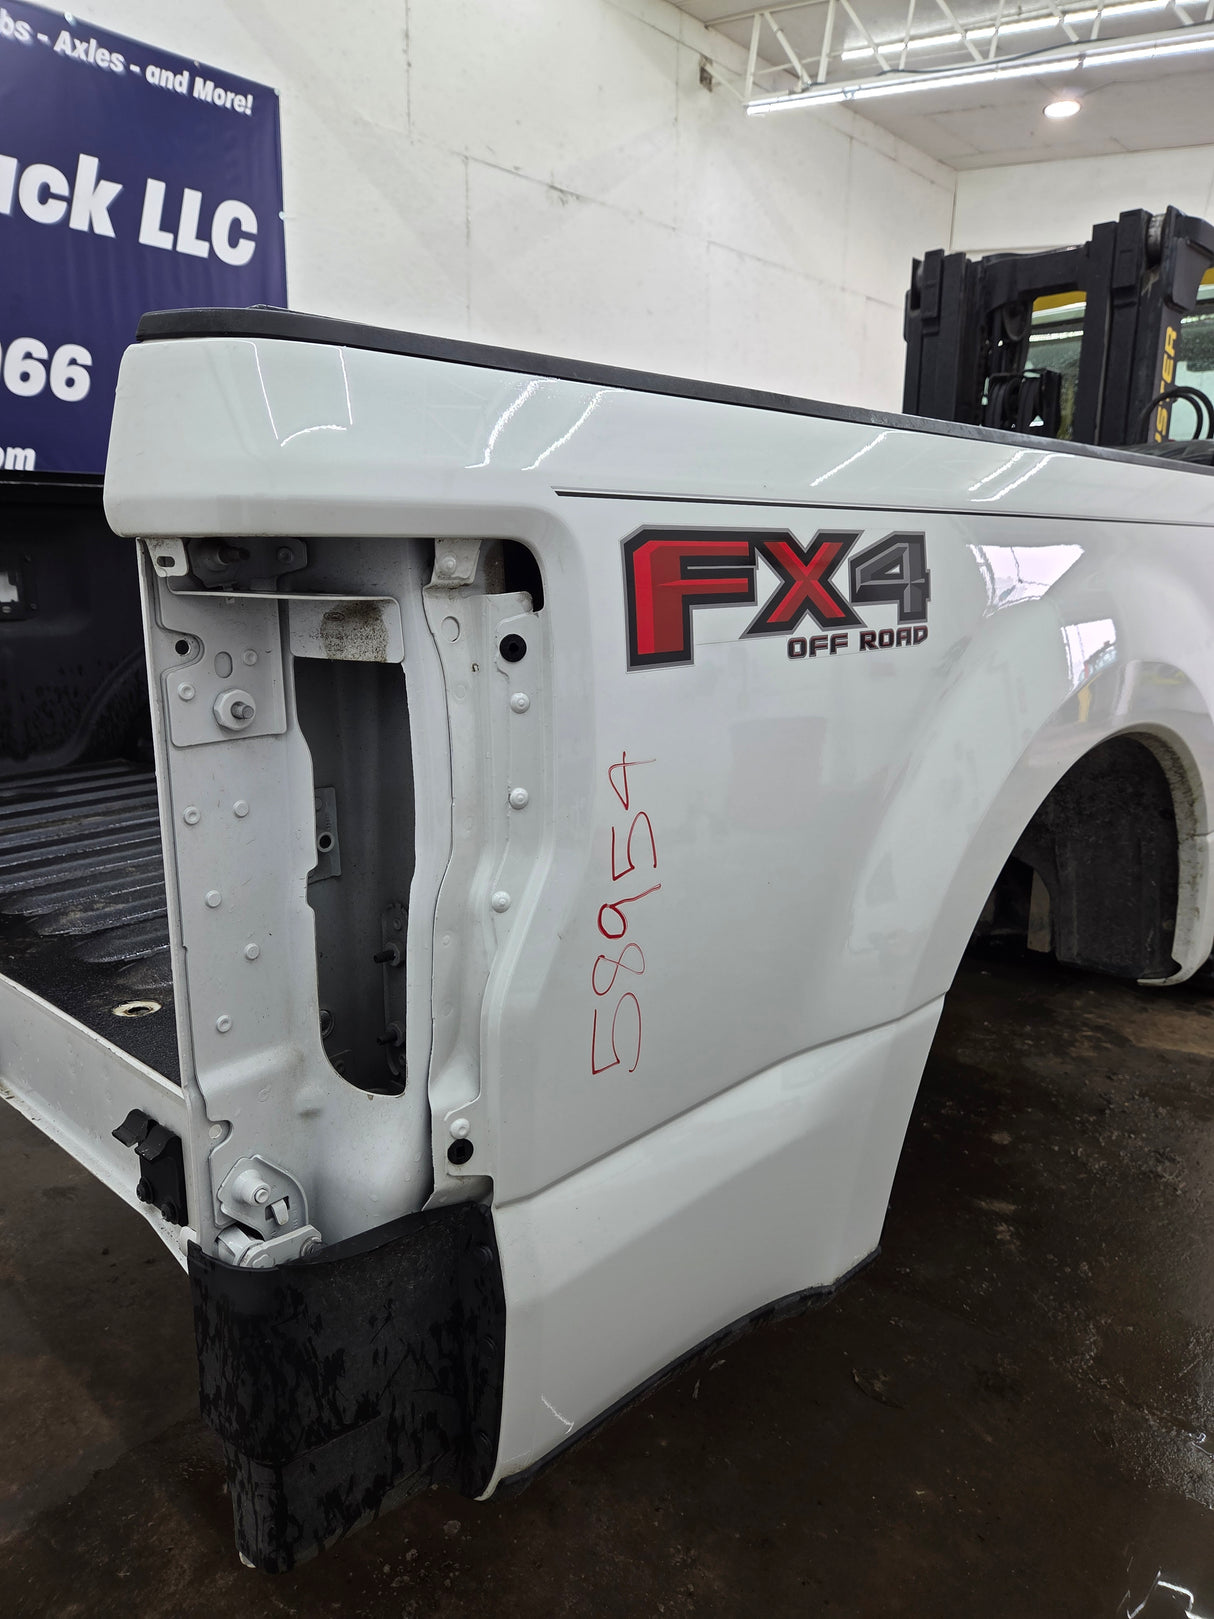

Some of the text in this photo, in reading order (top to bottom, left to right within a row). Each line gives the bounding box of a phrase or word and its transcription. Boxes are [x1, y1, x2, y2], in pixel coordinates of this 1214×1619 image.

[53, 30, 126, 73] Axles
[146, 65, 190, 95] and
[193, 76, 253, 115] More!
[139, 178, 258, 266] LLC
[0, 337, 93, 402] 66
[620, 524, 931, 672] FX4
[787, 625, 928, 660] OFF ROAD
[592, 751, 661, 1075] 58954
